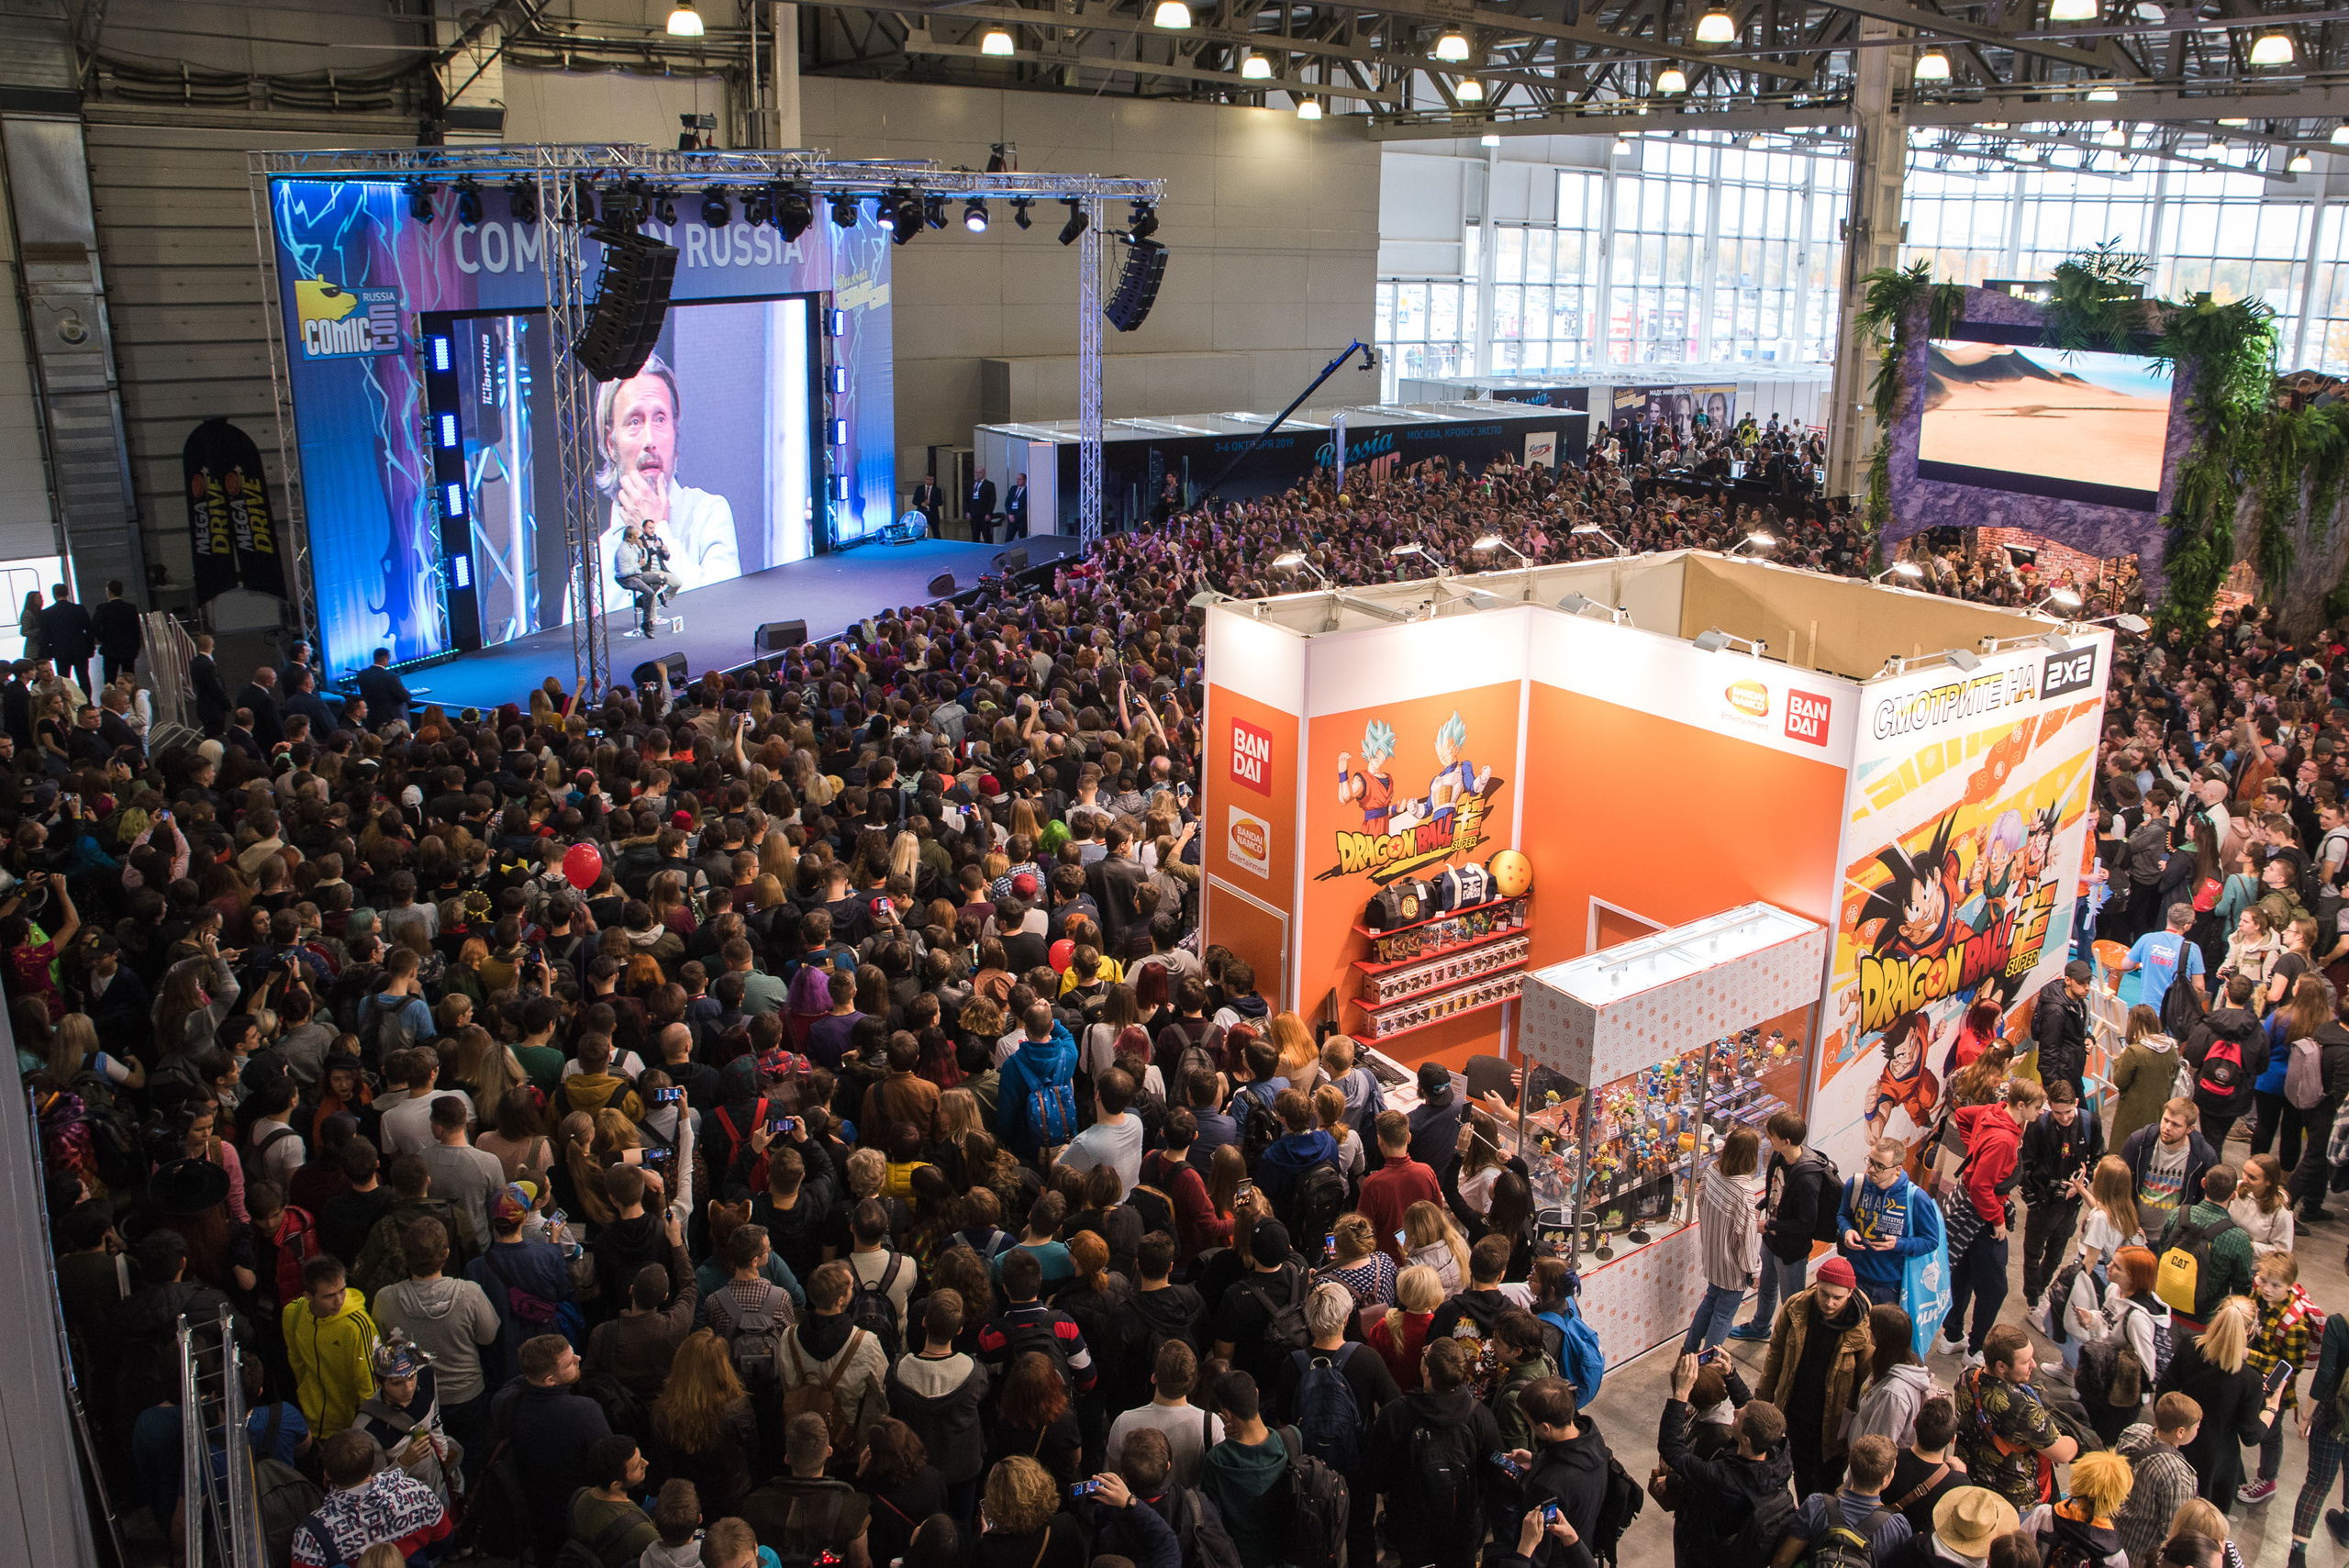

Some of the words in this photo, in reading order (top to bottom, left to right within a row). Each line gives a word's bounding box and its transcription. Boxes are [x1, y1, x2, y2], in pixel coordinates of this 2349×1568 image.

[453, 222, 588, 273] COM
[685, 222, 805, 268] RUSSIA
[363, 292, 395, 302] RUSSIA
[305, 317, 373, 356] COMIC
[1215, 442, 1230, 452] 3-6
[1275, 439, 1295, 449] 2019
[1315, 430, 1395, 469] Rssia
[206, 475, 230, 554] DRIVE
[229, 499, 255, 552] MEGA
[241, 474, 273, 554] DRIVE
[194, 501, 211, 556] MEGA
[1731, 686, 1765, 703] BANDAI
[1731, 695, 1765, 711] NAMCO
[1790, 695, 1828, 722] BAN
[1874, 671, 2004, 740] СМОТРИТЕ
[2005, 663, 2035, 706] НА
[1787, 713, 1818, 738] DAI
[1234, 727, 1269, 763] BAN
[1233, 751, 1262, 784] DAI
[1236, 834, 1264, 854] NAMCO
[1237, 825, 1263, 845] BANDAI
[1336, 828, 1416, 873] DRAGON
[1415, 814, 1453, 854] BALL
[1451, 836, 1477, 852] SUPER
[1229, 850, 1267, 876] Entertainment
[1861, 943, 1965, 1037] DRAGON
[1962, 910, 2015, 987] BALL
[2005, 949, 2039, 977] SUPER
[2150, 955, 2175, 968] STAFF
[2171, 1255, 2190, 1270] CAT
